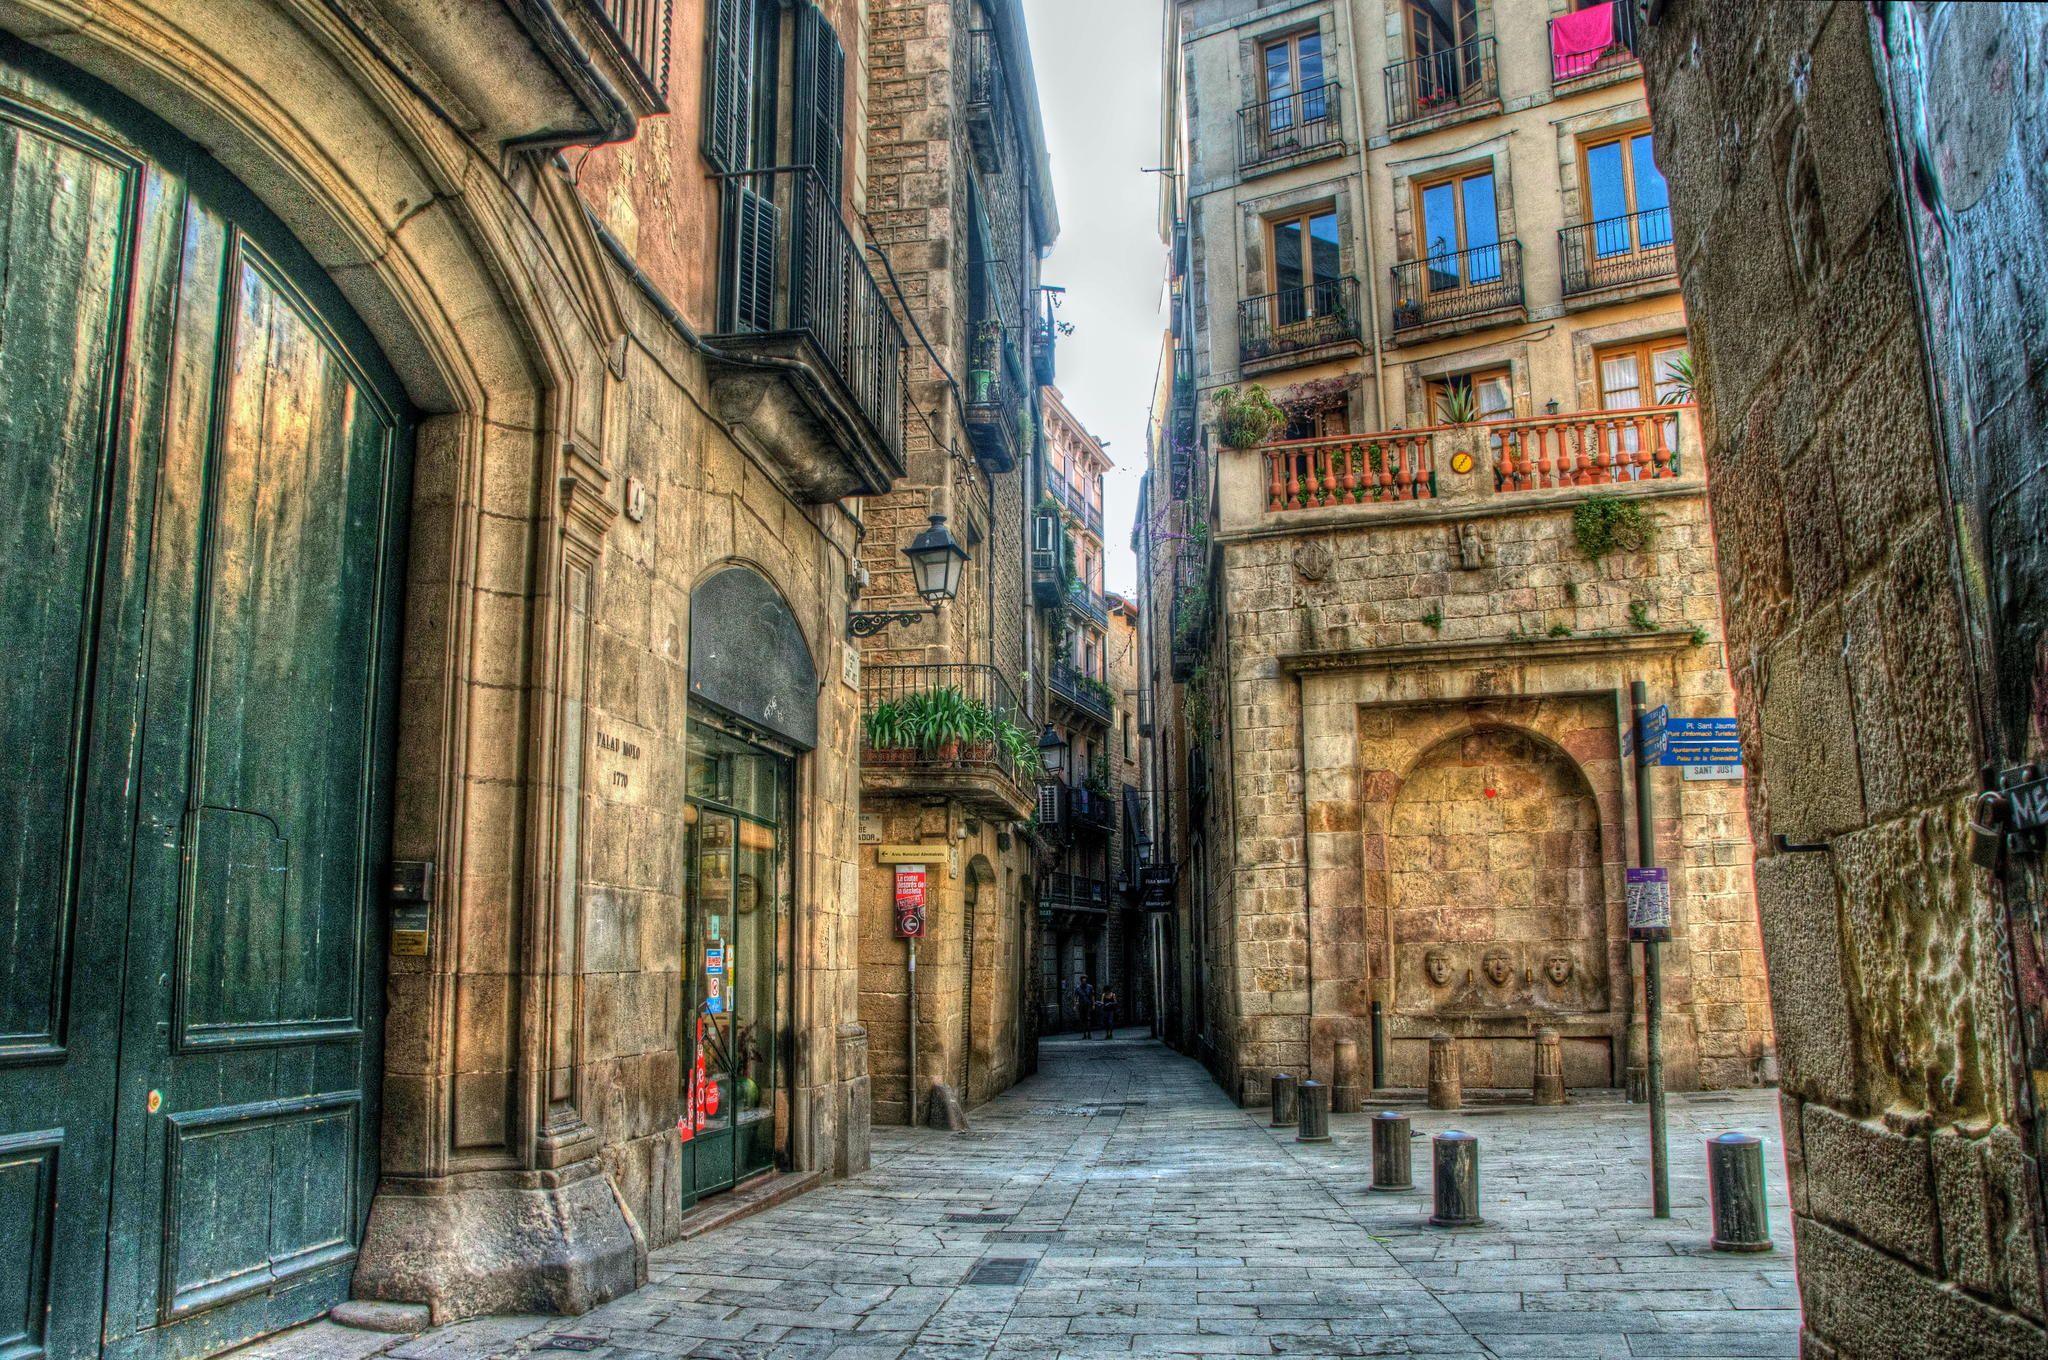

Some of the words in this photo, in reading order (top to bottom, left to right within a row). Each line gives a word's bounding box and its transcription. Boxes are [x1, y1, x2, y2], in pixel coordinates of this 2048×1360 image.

[597, 732, 620, 752] PALAU
[1694, 766, 1712, 775] SANT
[1716, 766, 1733, 774] JUST
